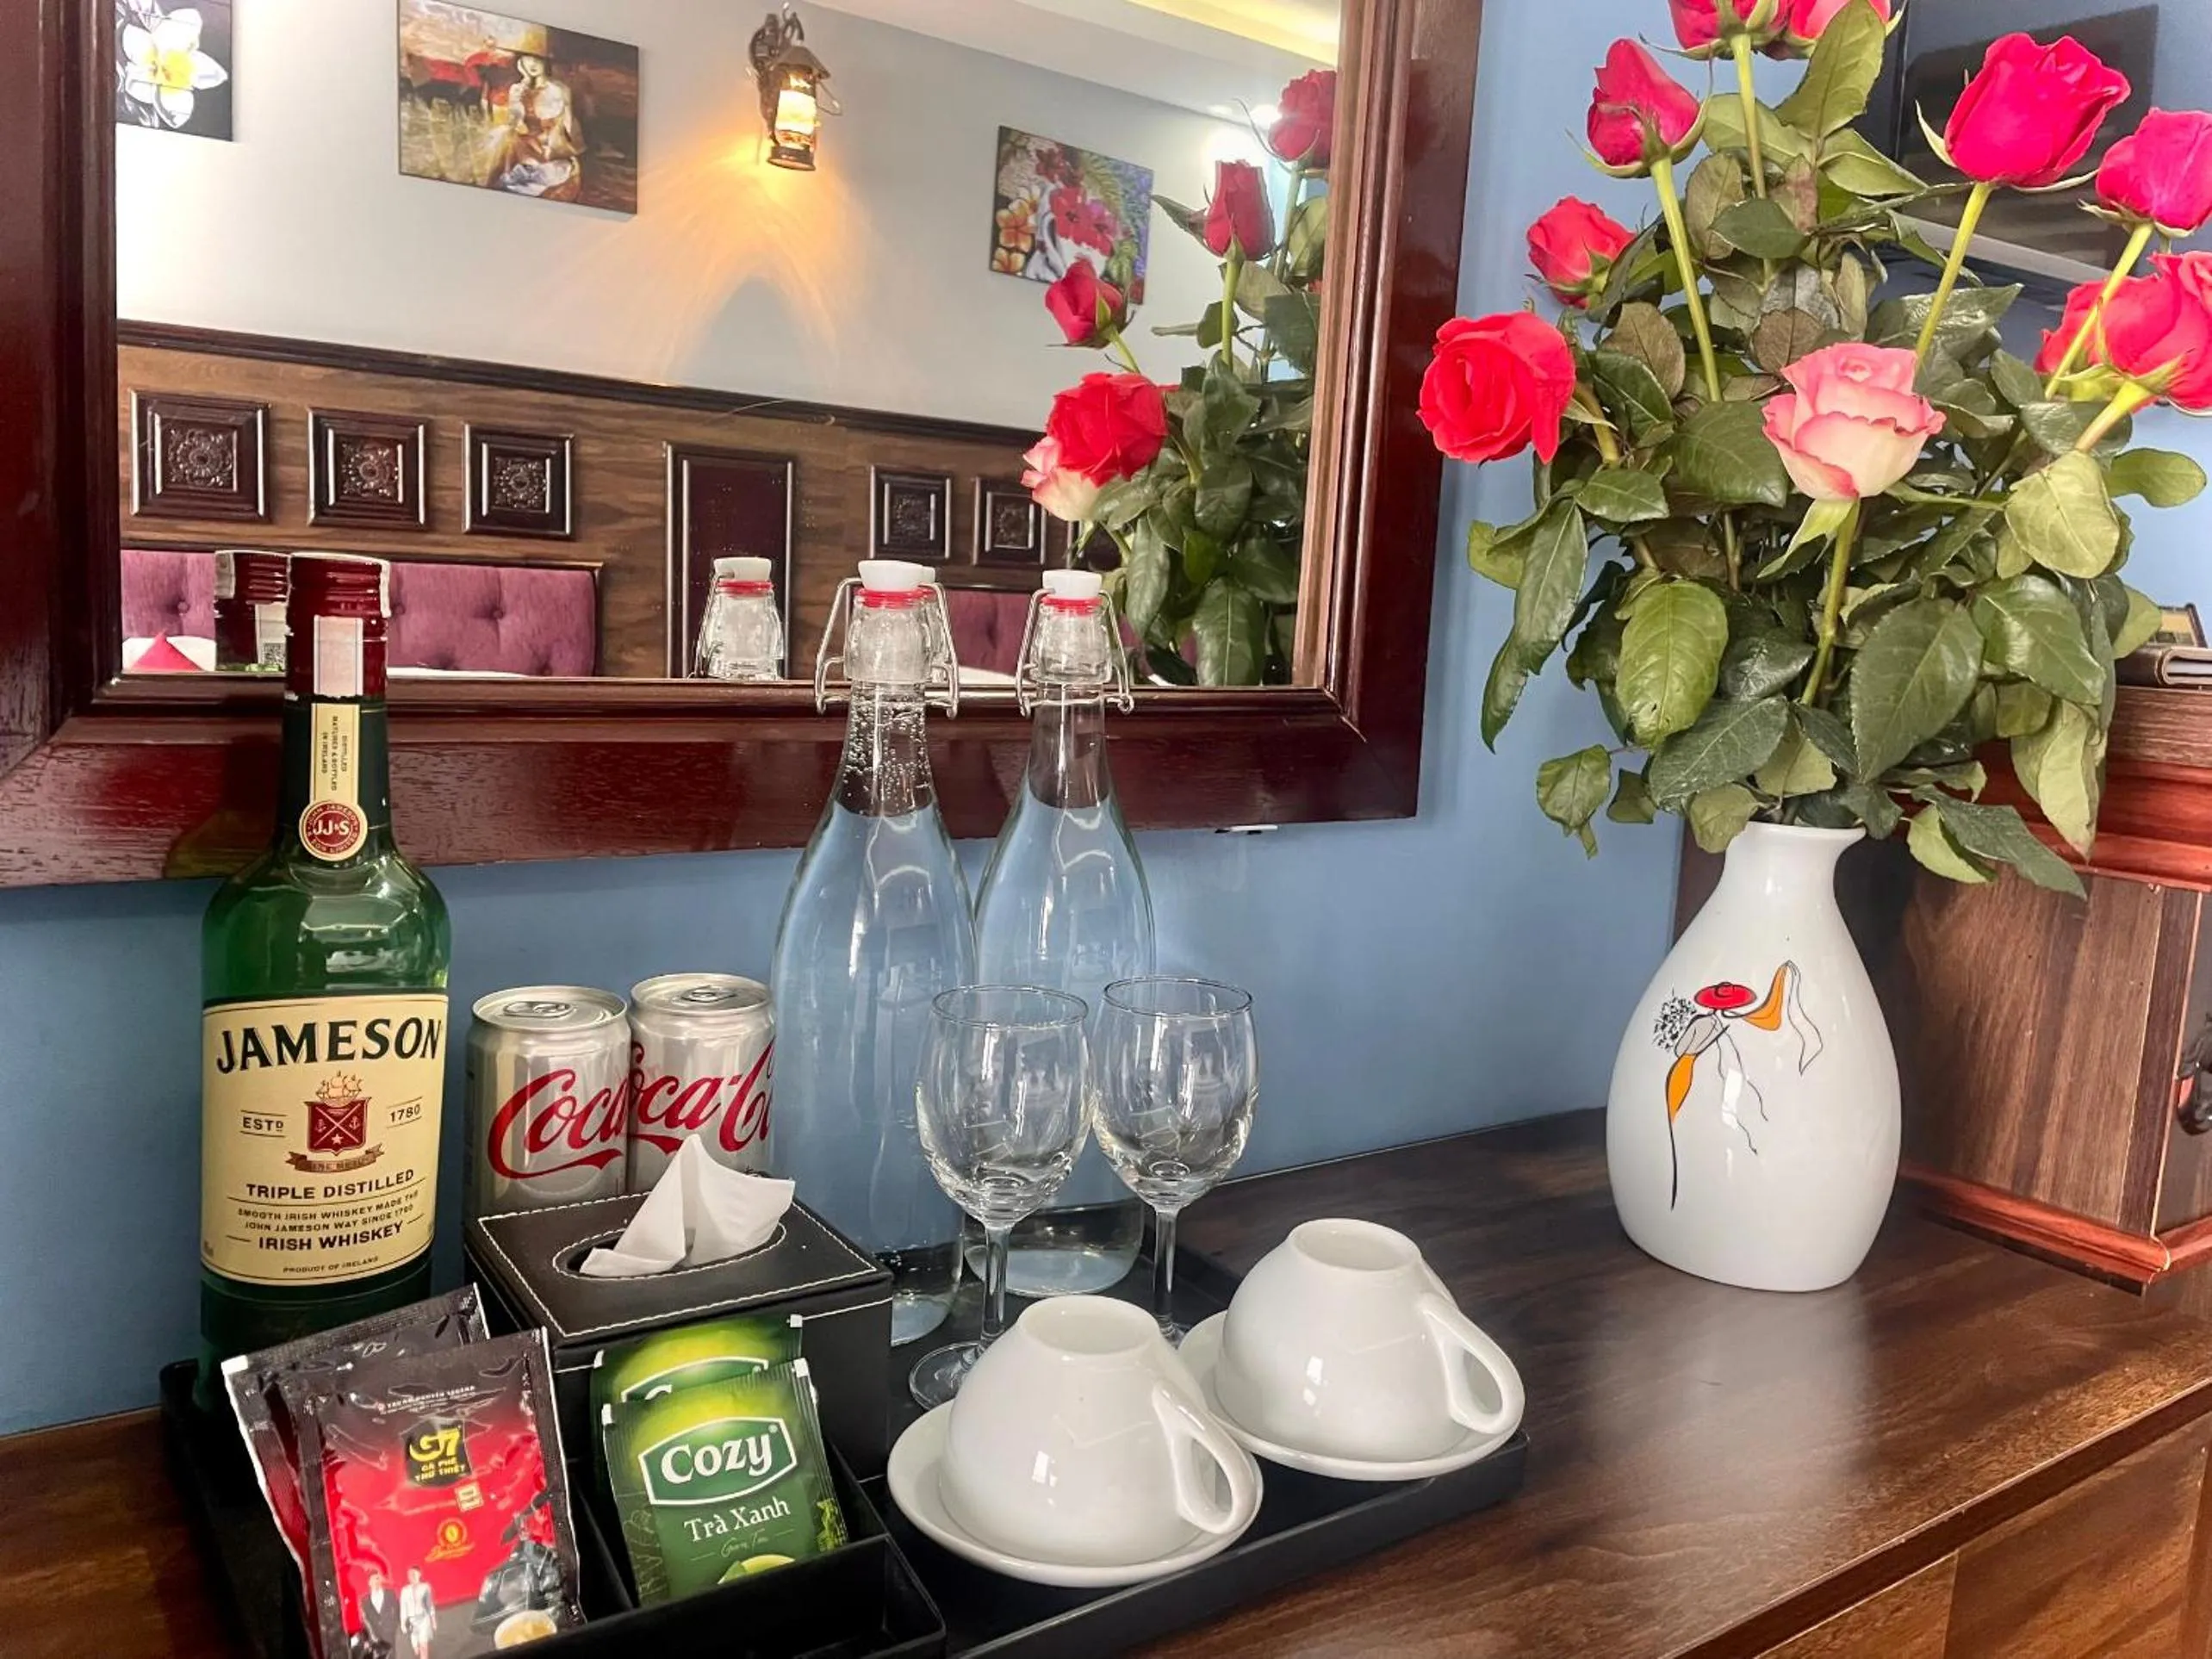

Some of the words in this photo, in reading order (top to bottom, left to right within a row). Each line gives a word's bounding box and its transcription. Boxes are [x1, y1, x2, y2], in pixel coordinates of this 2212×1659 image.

[216, 1016, 442, 1074] JAMESON
[389, 1103, 421, 1122] 1780
[246, 1183, 315, 1200] TRIPLE
[324, 1168, 414, 1198] DISTILLED
[238, 1208, 282, 1221] SMOOTH
[285, 1212, 317, 1221] IRISH
[320, 1206, 373, 1220] WHISKEY
[376, 1196, 402, 1212] MADE
[245, 1221, 271, 1232] JOHN
[275, 1223, 330, 1233] JAMESON
[333, 1220, 358, 1230] WAY
[361, 1214, 392, 1226] SINCE
[258, 1236, 313, 1251] IRISH
[319, 1221, 403, 1249] WHISKEY
[283, 1265, 326, 1274] PRODUCT
[342, 1255, 379, 1269] IRELAND
[409, 1426, 461, 1463] G7
[660, 1432, 773, 1484] Cozy
[683, 1513, 730, 1543] Trà
[729, 1495, 792, 1531] Xanh
